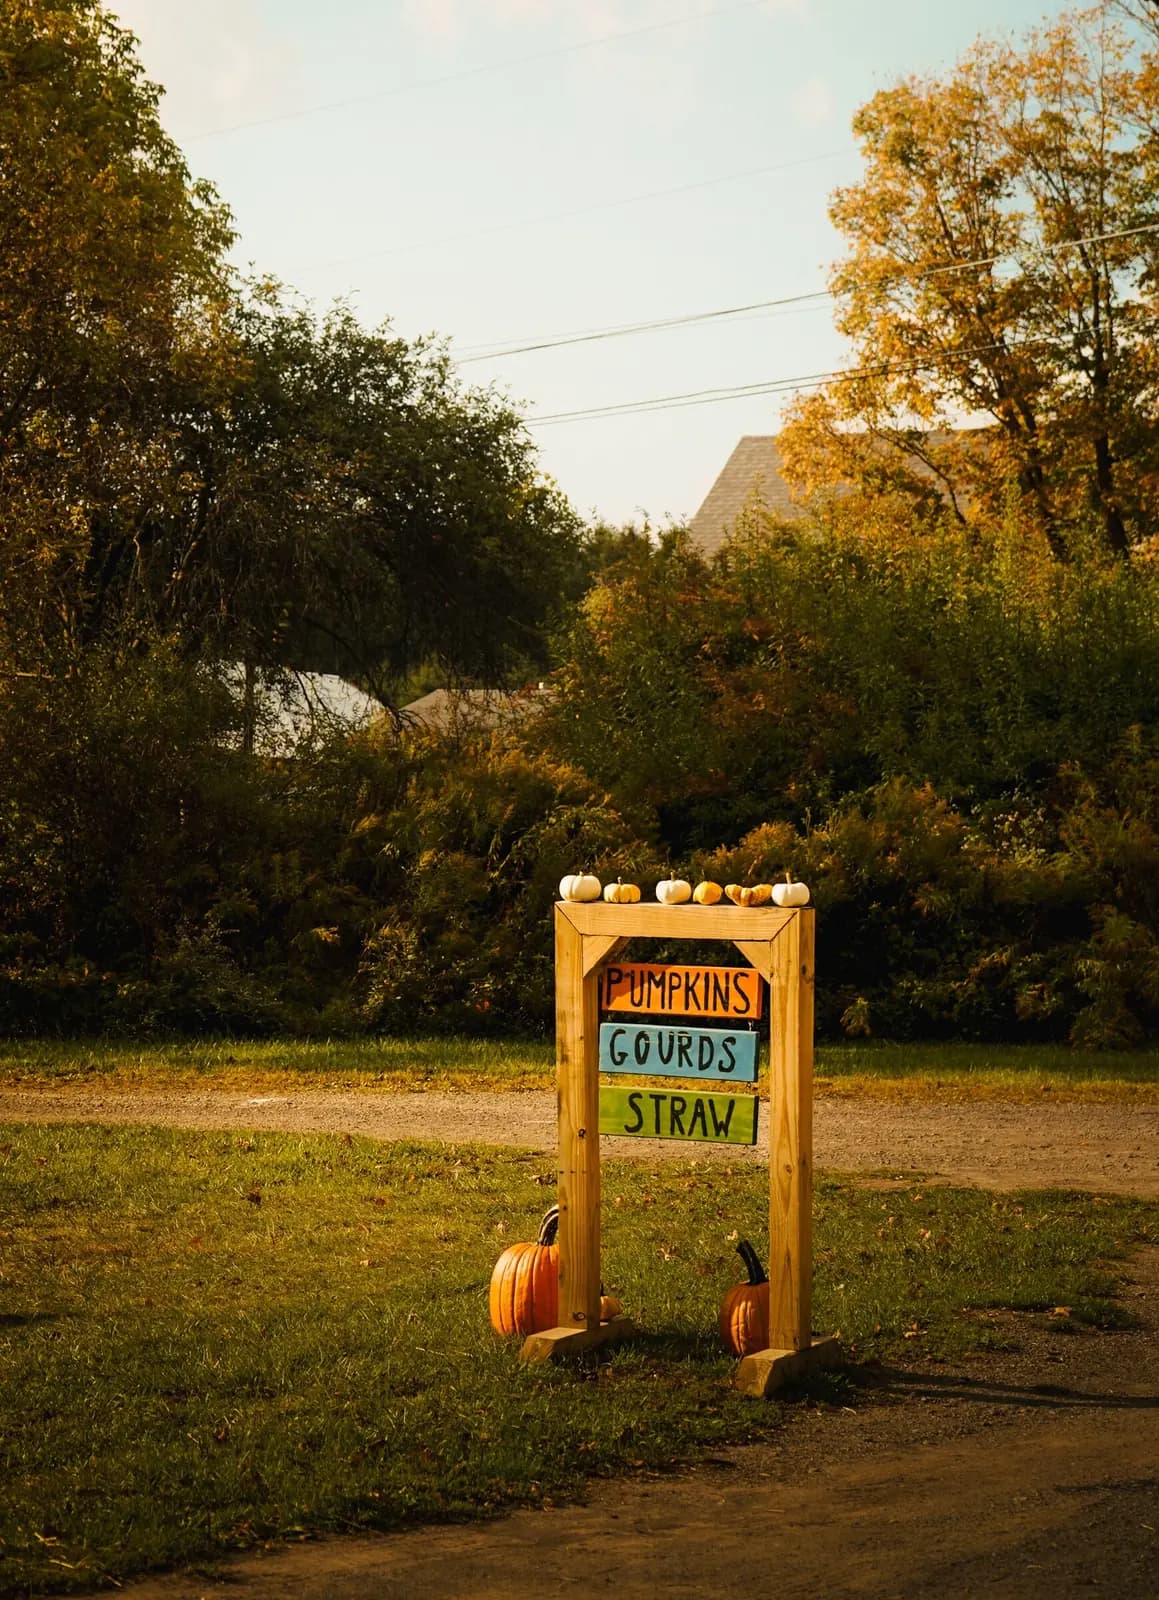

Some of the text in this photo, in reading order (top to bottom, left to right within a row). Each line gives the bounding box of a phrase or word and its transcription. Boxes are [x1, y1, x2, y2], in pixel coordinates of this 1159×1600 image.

[605, 966, 752, 1015] PUMPKINS
[609, 1028, 737, 1073] GOURDS
[624, 1091, 736, 1138] STRAW
